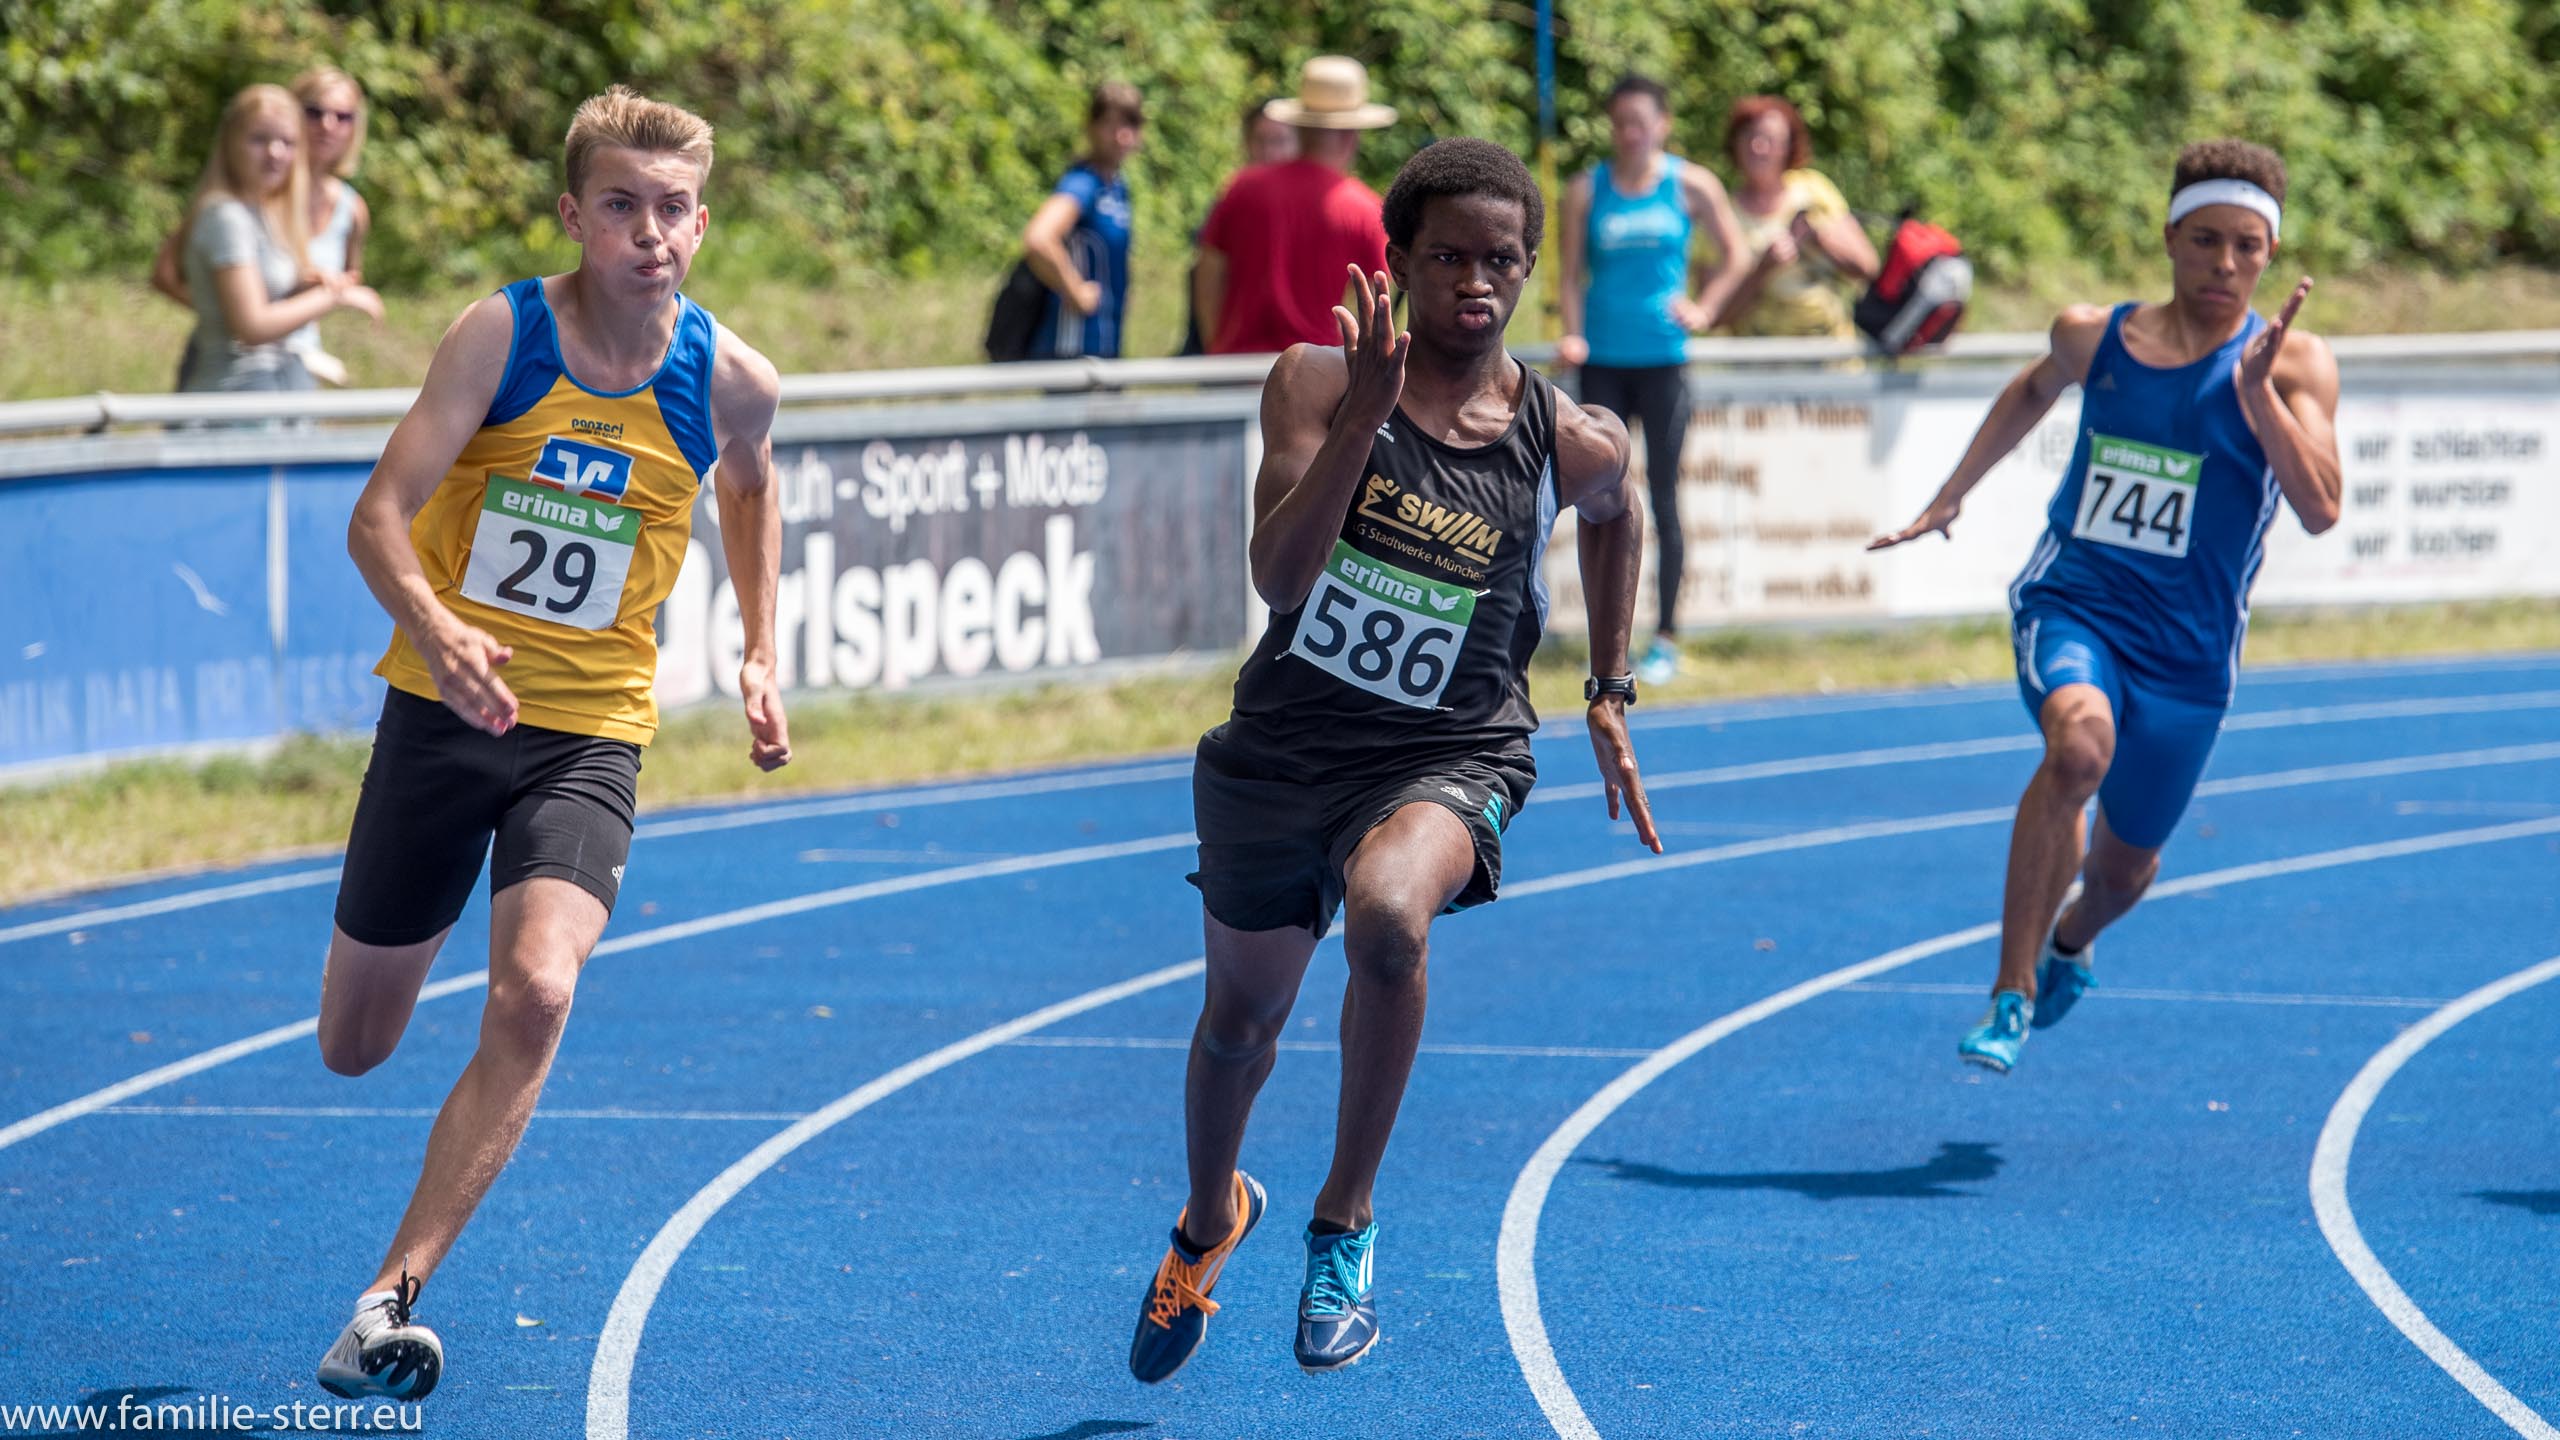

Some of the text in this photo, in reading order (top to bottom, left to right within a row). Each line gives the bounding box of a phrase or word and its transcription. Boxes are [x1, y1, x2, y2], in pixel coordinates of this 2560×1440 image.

[571, 418, 624, 435] panzeri
[861, 440, 970, 534] Sport
[1004, 432, 1109, 508] Mode
[2102, 444, 2162, 473] erima
[501, 489, 588, 529] erima
[2086, 473, 2185, 547] 744
[495, 529, 597, 615] 29
[1339, 557, 1423, 607] erima
[1368, 527, 1433, 563] Stadtwerke
[1434, 554, 1486, 583] München
[1303, 584, 1454, 698] 586
